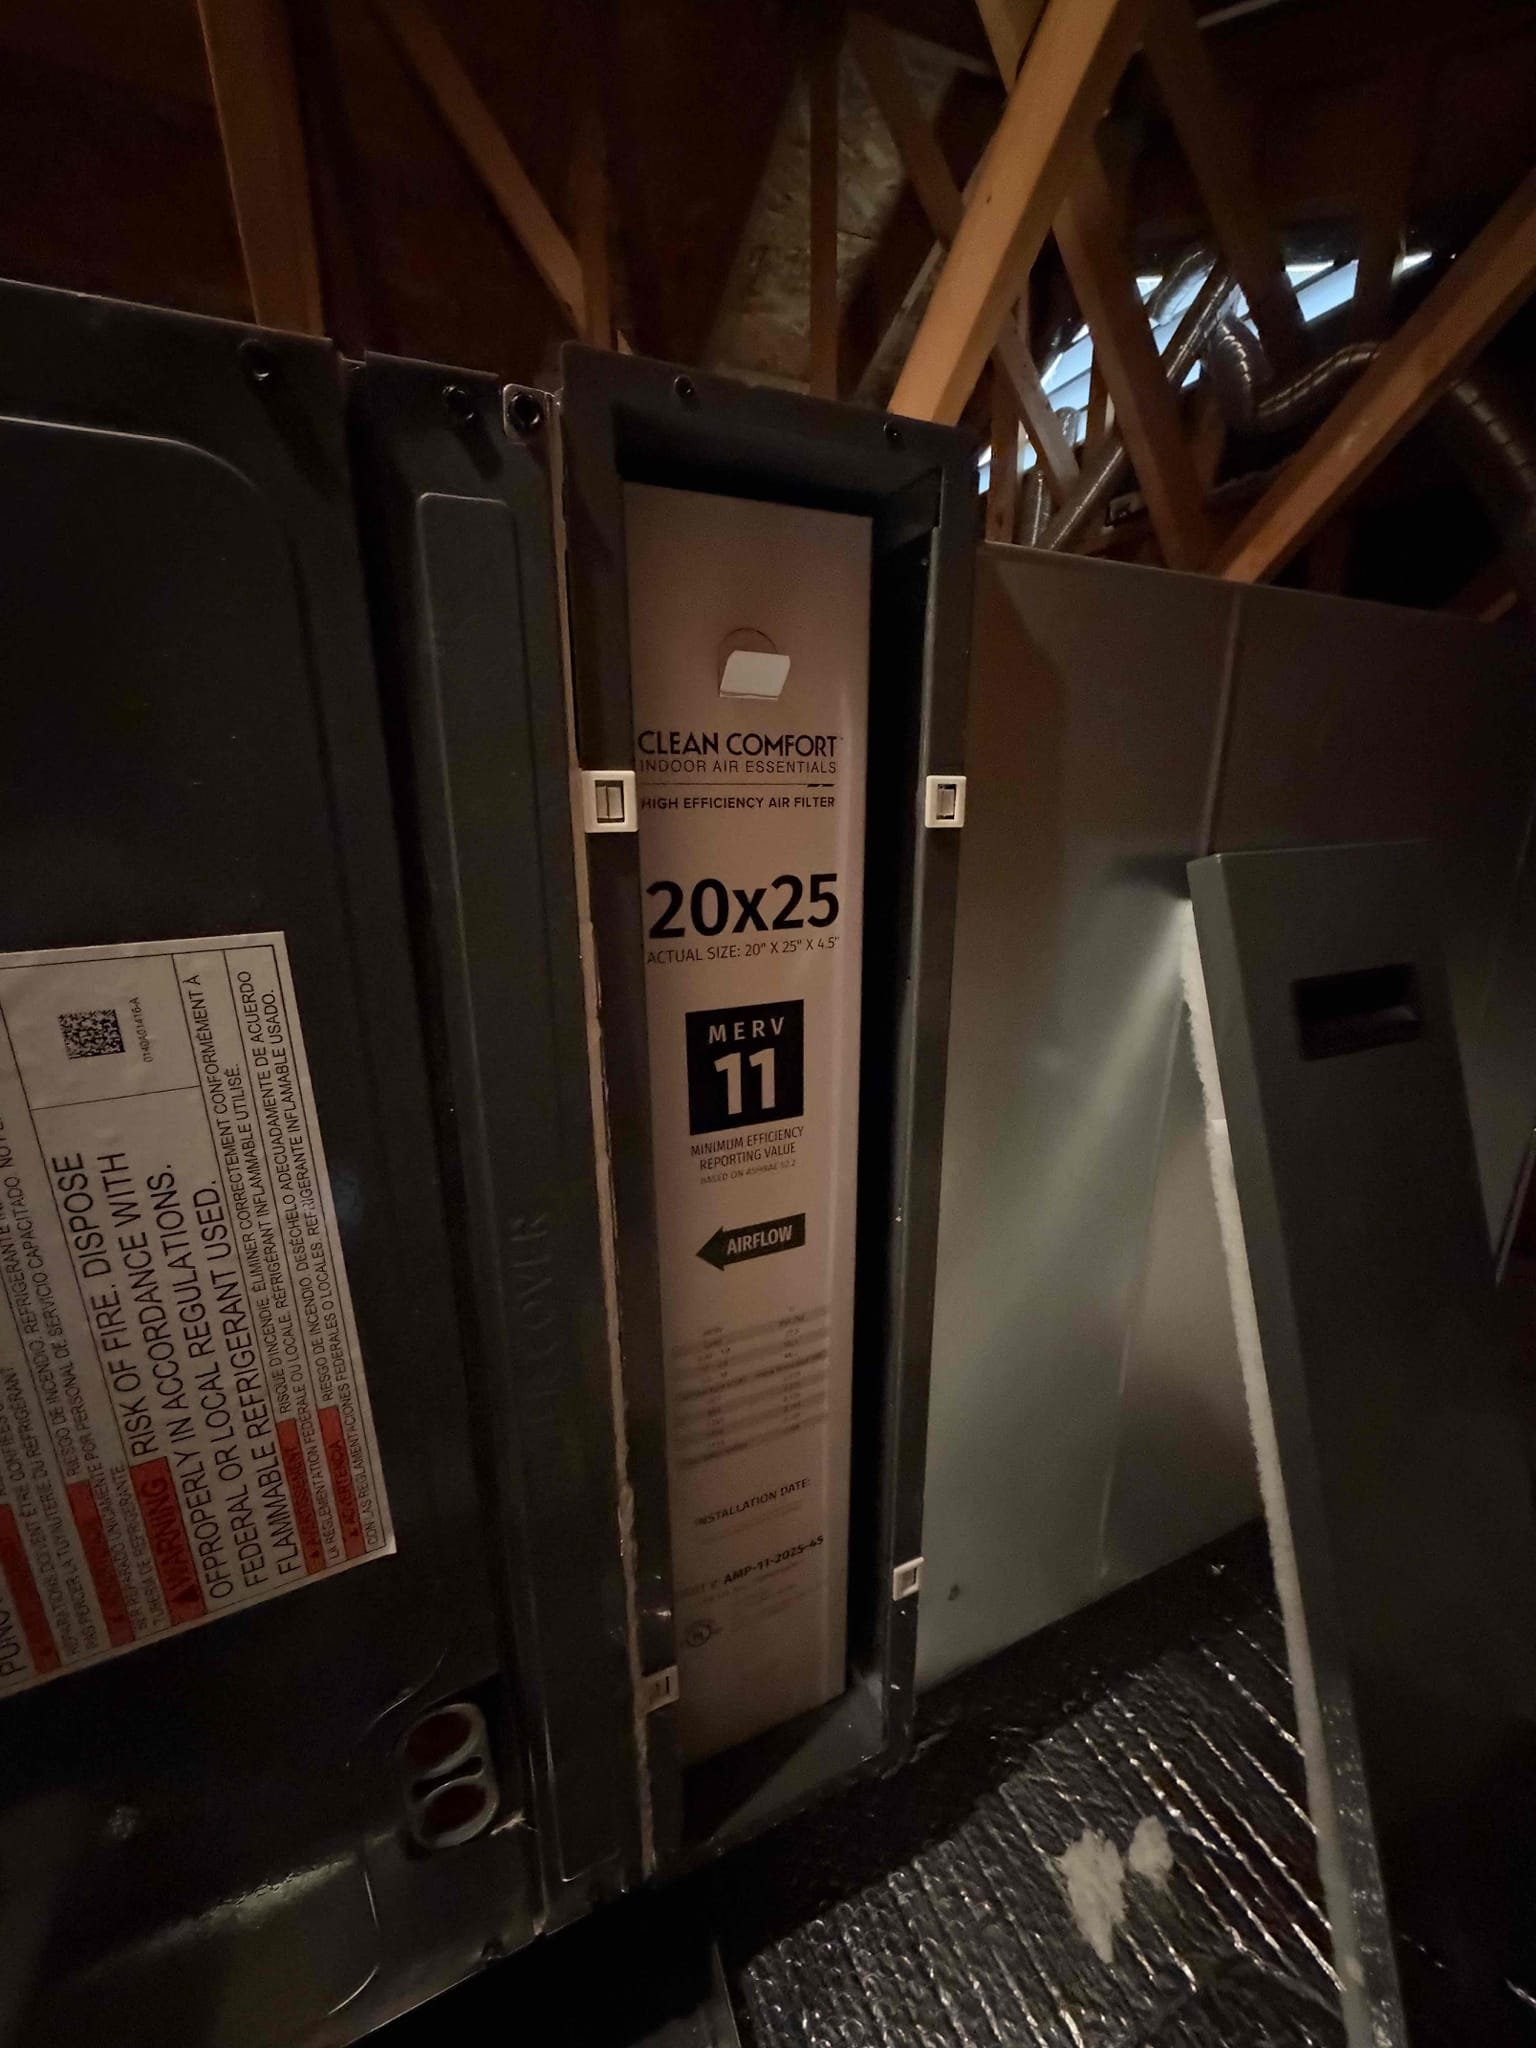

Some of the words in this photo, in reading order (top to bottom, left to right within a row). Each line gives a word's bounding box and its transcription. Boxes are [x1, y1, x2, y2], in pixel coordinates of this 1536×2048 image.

[638, 731, 719, 754] CLEAN
[727, 733, 837, 756] COMFORT
[640, 760, 706, 772] INDOOR
[713, 761, 738, 773] AIR
[746, 761, 836, 773] ESSENTIALS
[641, 797, 678, 809] HIGH
[684, 797, 763, 809] EFFICIENCY
[769, 797, 789, 807] AIR
[794, 797, 834, 807] FILTER
[646, 873, 840, 939] 20x25
[181, 974, 201, 985] À
[648, 949, 702, 964] ACTUAL
[707, 945, 740, 960] SIZE:
[771, 942, 778, 954] X
[806, 938, 813, 950] X
[236, 970, 265, 1043] ACUERDO
[260, 989, 283, 1045] USADO.
[708, 1016, 784, 1044] MERV
[187, 990, 228, 1114] CONFORMÉMENT
[251, 1045, 269, 1067] DE
[714, 1048, 775, 1115] 11
[222, 1062, 249, 1121] UTILISÉ.
[270, 1046, 301, 1133] INFLAMABLE
[256, 1069, 293, 1190] ADECUADAMENTE
[690, 1136, 744, 1158] MINIMUM
[747, 1126, 804, 1148] EFFICIENCY
[700, 1149, 761, 1171] REPORTING
[764, 1142, 796, 1159] VALUE
[96, 1152, 141, 1228] WITH
[215, 1119, 253, 1230] CORRECTEMENT
[236, 1122, 270, 1217] INFLAMMABLE
[288, 1135, 320, 1236] REFRIGERANTE
[50, 1152, 112, 1278] DISPOSE
[191, 1179, 232, 1261] USED.
[281, 1193, 309, 1272] DESÉCHELO
[727, 1225, 792, 1256] AIRFLOW
[145, 1163, 216, 1358] REGULATIONS.
[241, 1231, 267, 1293] ÉLIMINER
[256, 1220, 289, 1309] RÉFRIGÉRANT
[31, 1271, 63, 1337] SERVICIO
[89, 1283, 132, 1352] FIRE.
[117, 1230, 189, 1409] ACCORDANCE
[320, 1299, 334, 1311] O
[50, 1338, 70, 1359] DE
[106, 1358, 141, 1392] OF
[209, 1269, 272, 1439] REFRIGERANT
[287, 1363, 303, 1382] OU
[310, 1336, 325, 1355] DE
[322, 1311, 347, 1382] FEDERALES
[58, 1361, 90, 1430] PERSONAL
[193, 1361, 235, 1443] LOCAL
[270, 1367, 291, 1414] RISQUE
[314, 1356, 334, 1402] RIESGO
[48, 1406, 67, 1425] DE
[118, 1395, 159, 1457] RISK
[165, 1416, 196, 1444] IN
[336, 1382, 369, 1499] REGLAMENTACIONES
[213, 1443, 243, 1481] OR
[139, 1475, 195, 1591] WARNING
[172, 1450, 234, 1599] OFPROPERLY
[224, 1483, 268, 1588] FEDERAL
[250, 1440, 302, 1575] FLAMMABLE
[359, 1498, 374, 1521] LAS
[364, 1520, 378, 1545] CON
[695, 1490, 777, 1525] INSTALLATION
[327, 1544, 340, 1560] LA
